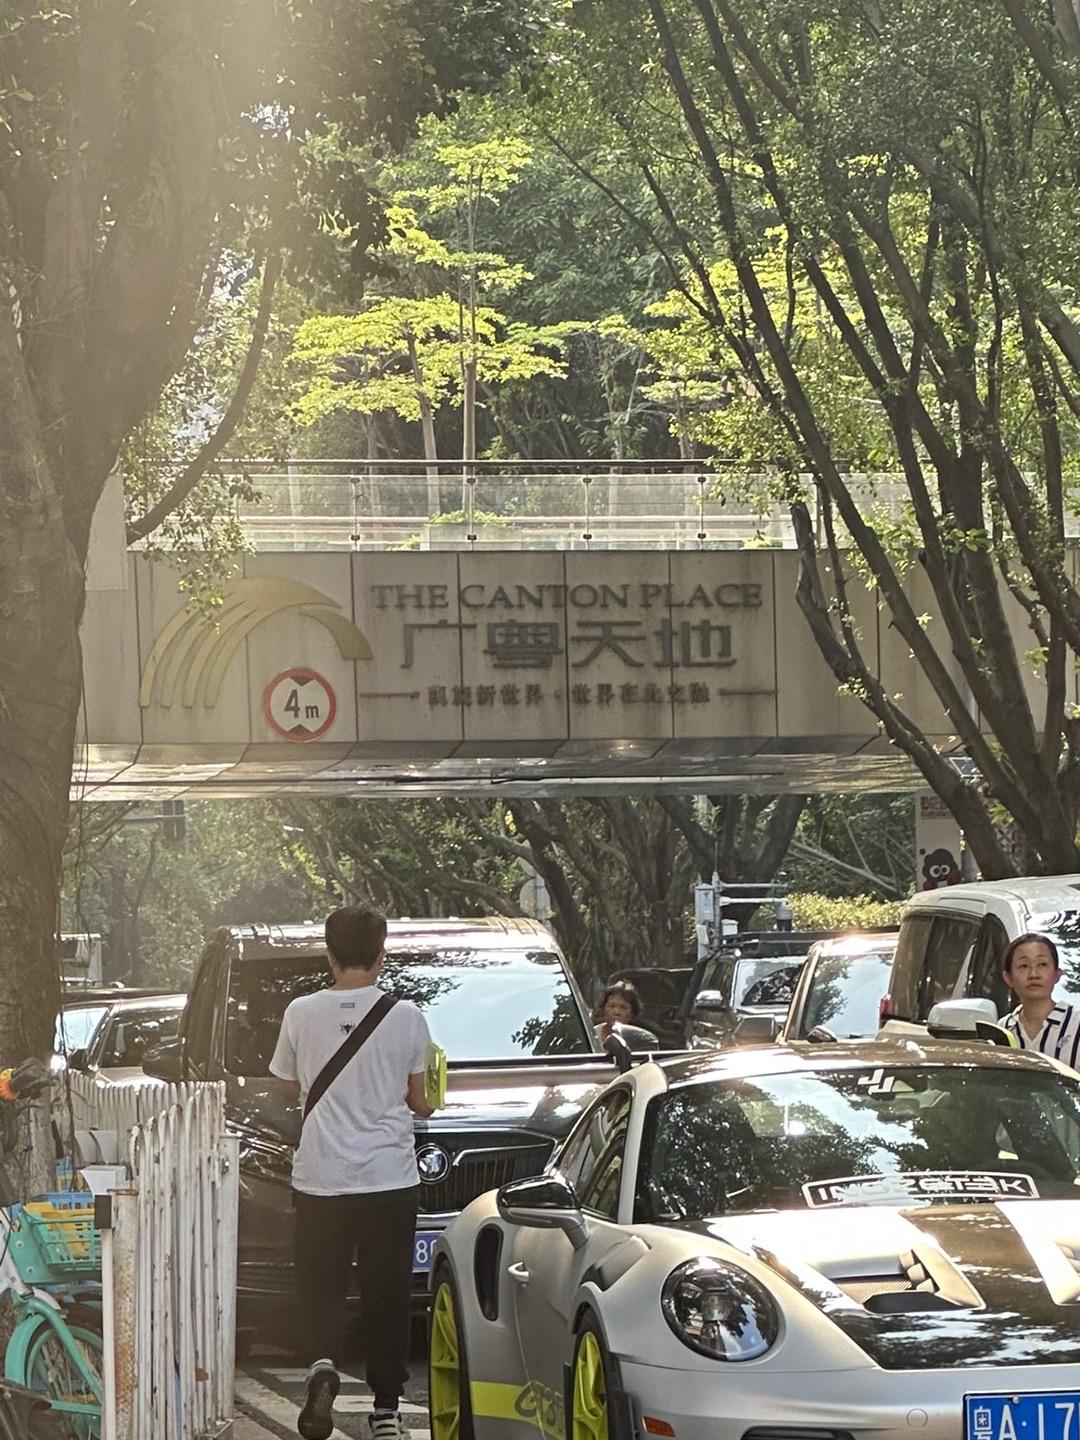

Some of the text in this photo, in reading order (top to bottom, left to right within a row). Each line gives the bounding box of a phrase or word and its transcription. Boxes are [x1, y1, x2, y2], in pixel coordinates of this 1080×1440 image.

[371, 583, 763, 609] THE CANTON PLACE
[400, 618, 737, 670] 广粤天地
[284, 689, 320, 719] 4m
